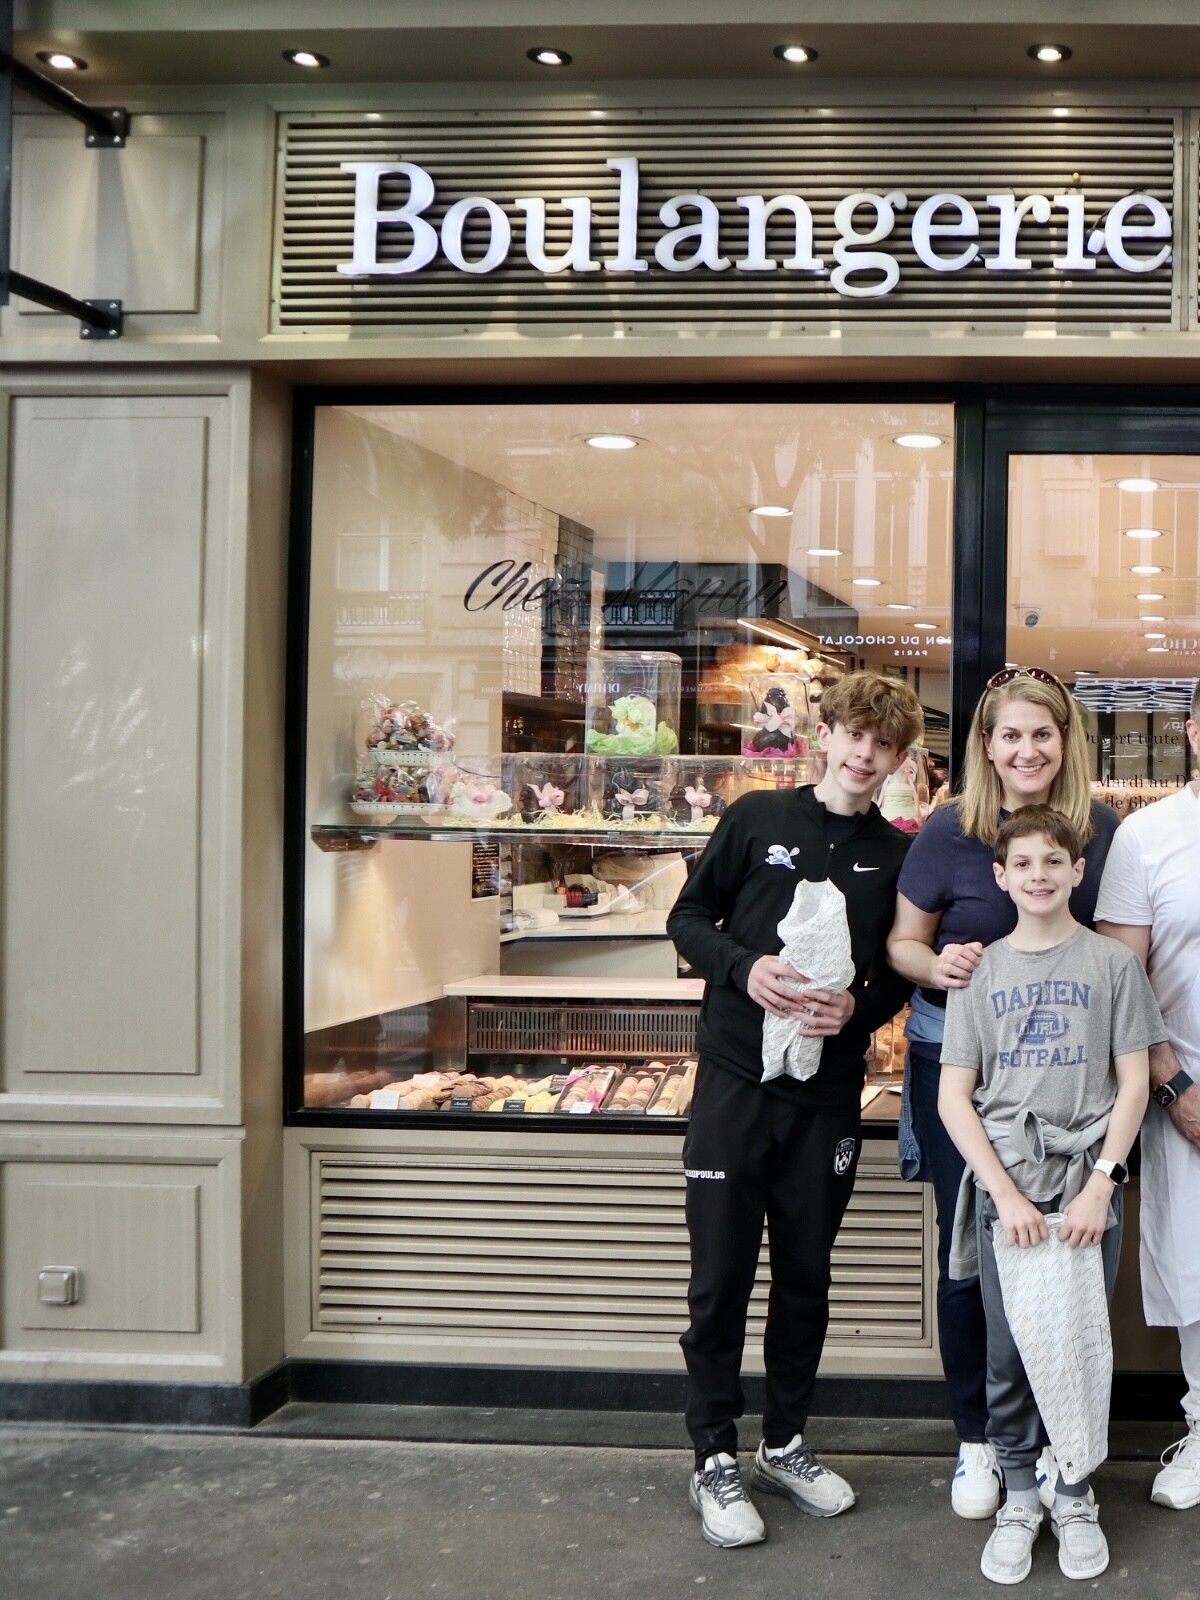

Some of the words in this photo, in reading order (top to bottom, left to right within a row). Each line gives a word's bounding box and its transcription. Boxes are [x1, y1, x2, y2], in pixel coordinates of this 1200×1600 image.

[336, 157, 1173, 298] Boulangerie
[463, 559, 591, 613] Chez
[1138, 733, 1179, 745] toute
[1096, 774, 1144, 788] Mardi
[1149, 777, 1169, 788] au
[990, 980, 1091, 1019] DARIEN
